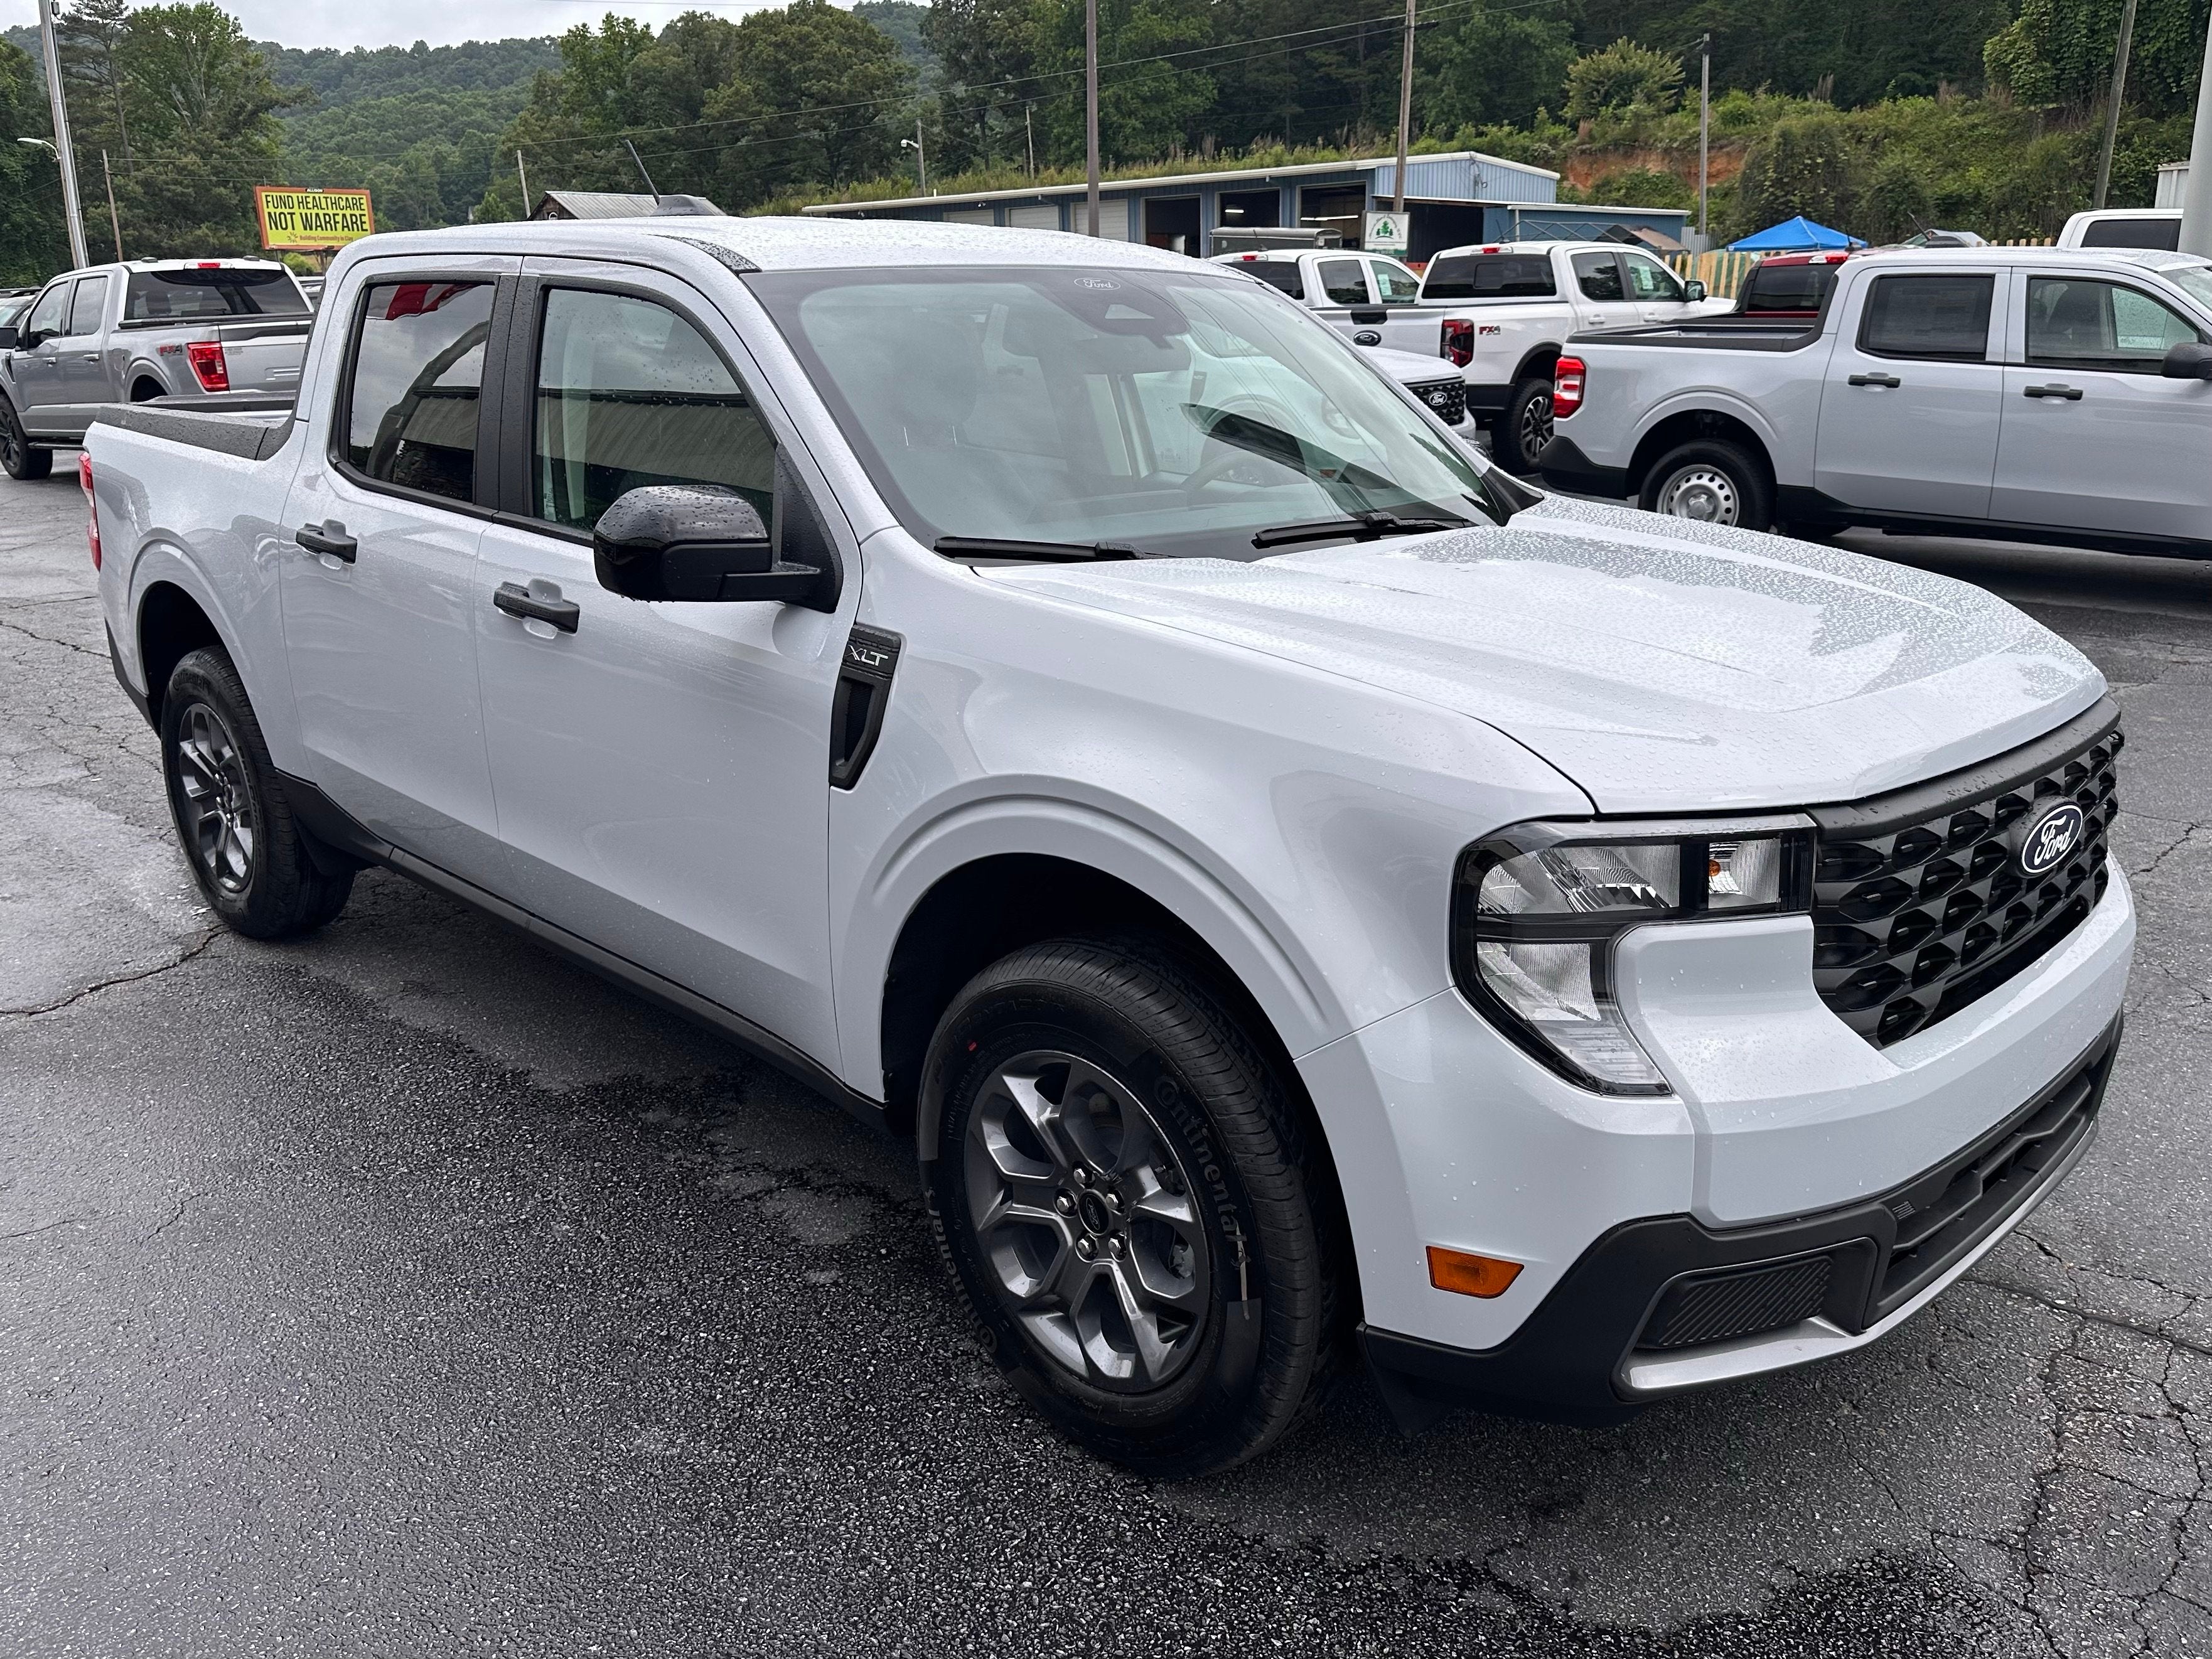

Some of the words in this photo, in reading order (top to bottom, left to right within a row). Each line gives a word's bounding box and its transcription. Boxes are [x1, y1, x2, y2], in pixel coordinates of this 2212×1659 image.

[265, 195, 294, 210] FUND
[297, 195, 365, 212] HEALTHCARE
[267, 212, 296, 231] NOT
[299, 212, 368, 232] WARFARE
[1083, 278, 1114, 288] Ford
[1479, 325, 1501, 335] FX4
[844, 645, 889, 667] XLT
[2034, 814, 2074, 866] Ford
[1154, 1075, 1248, 1242] Continental
